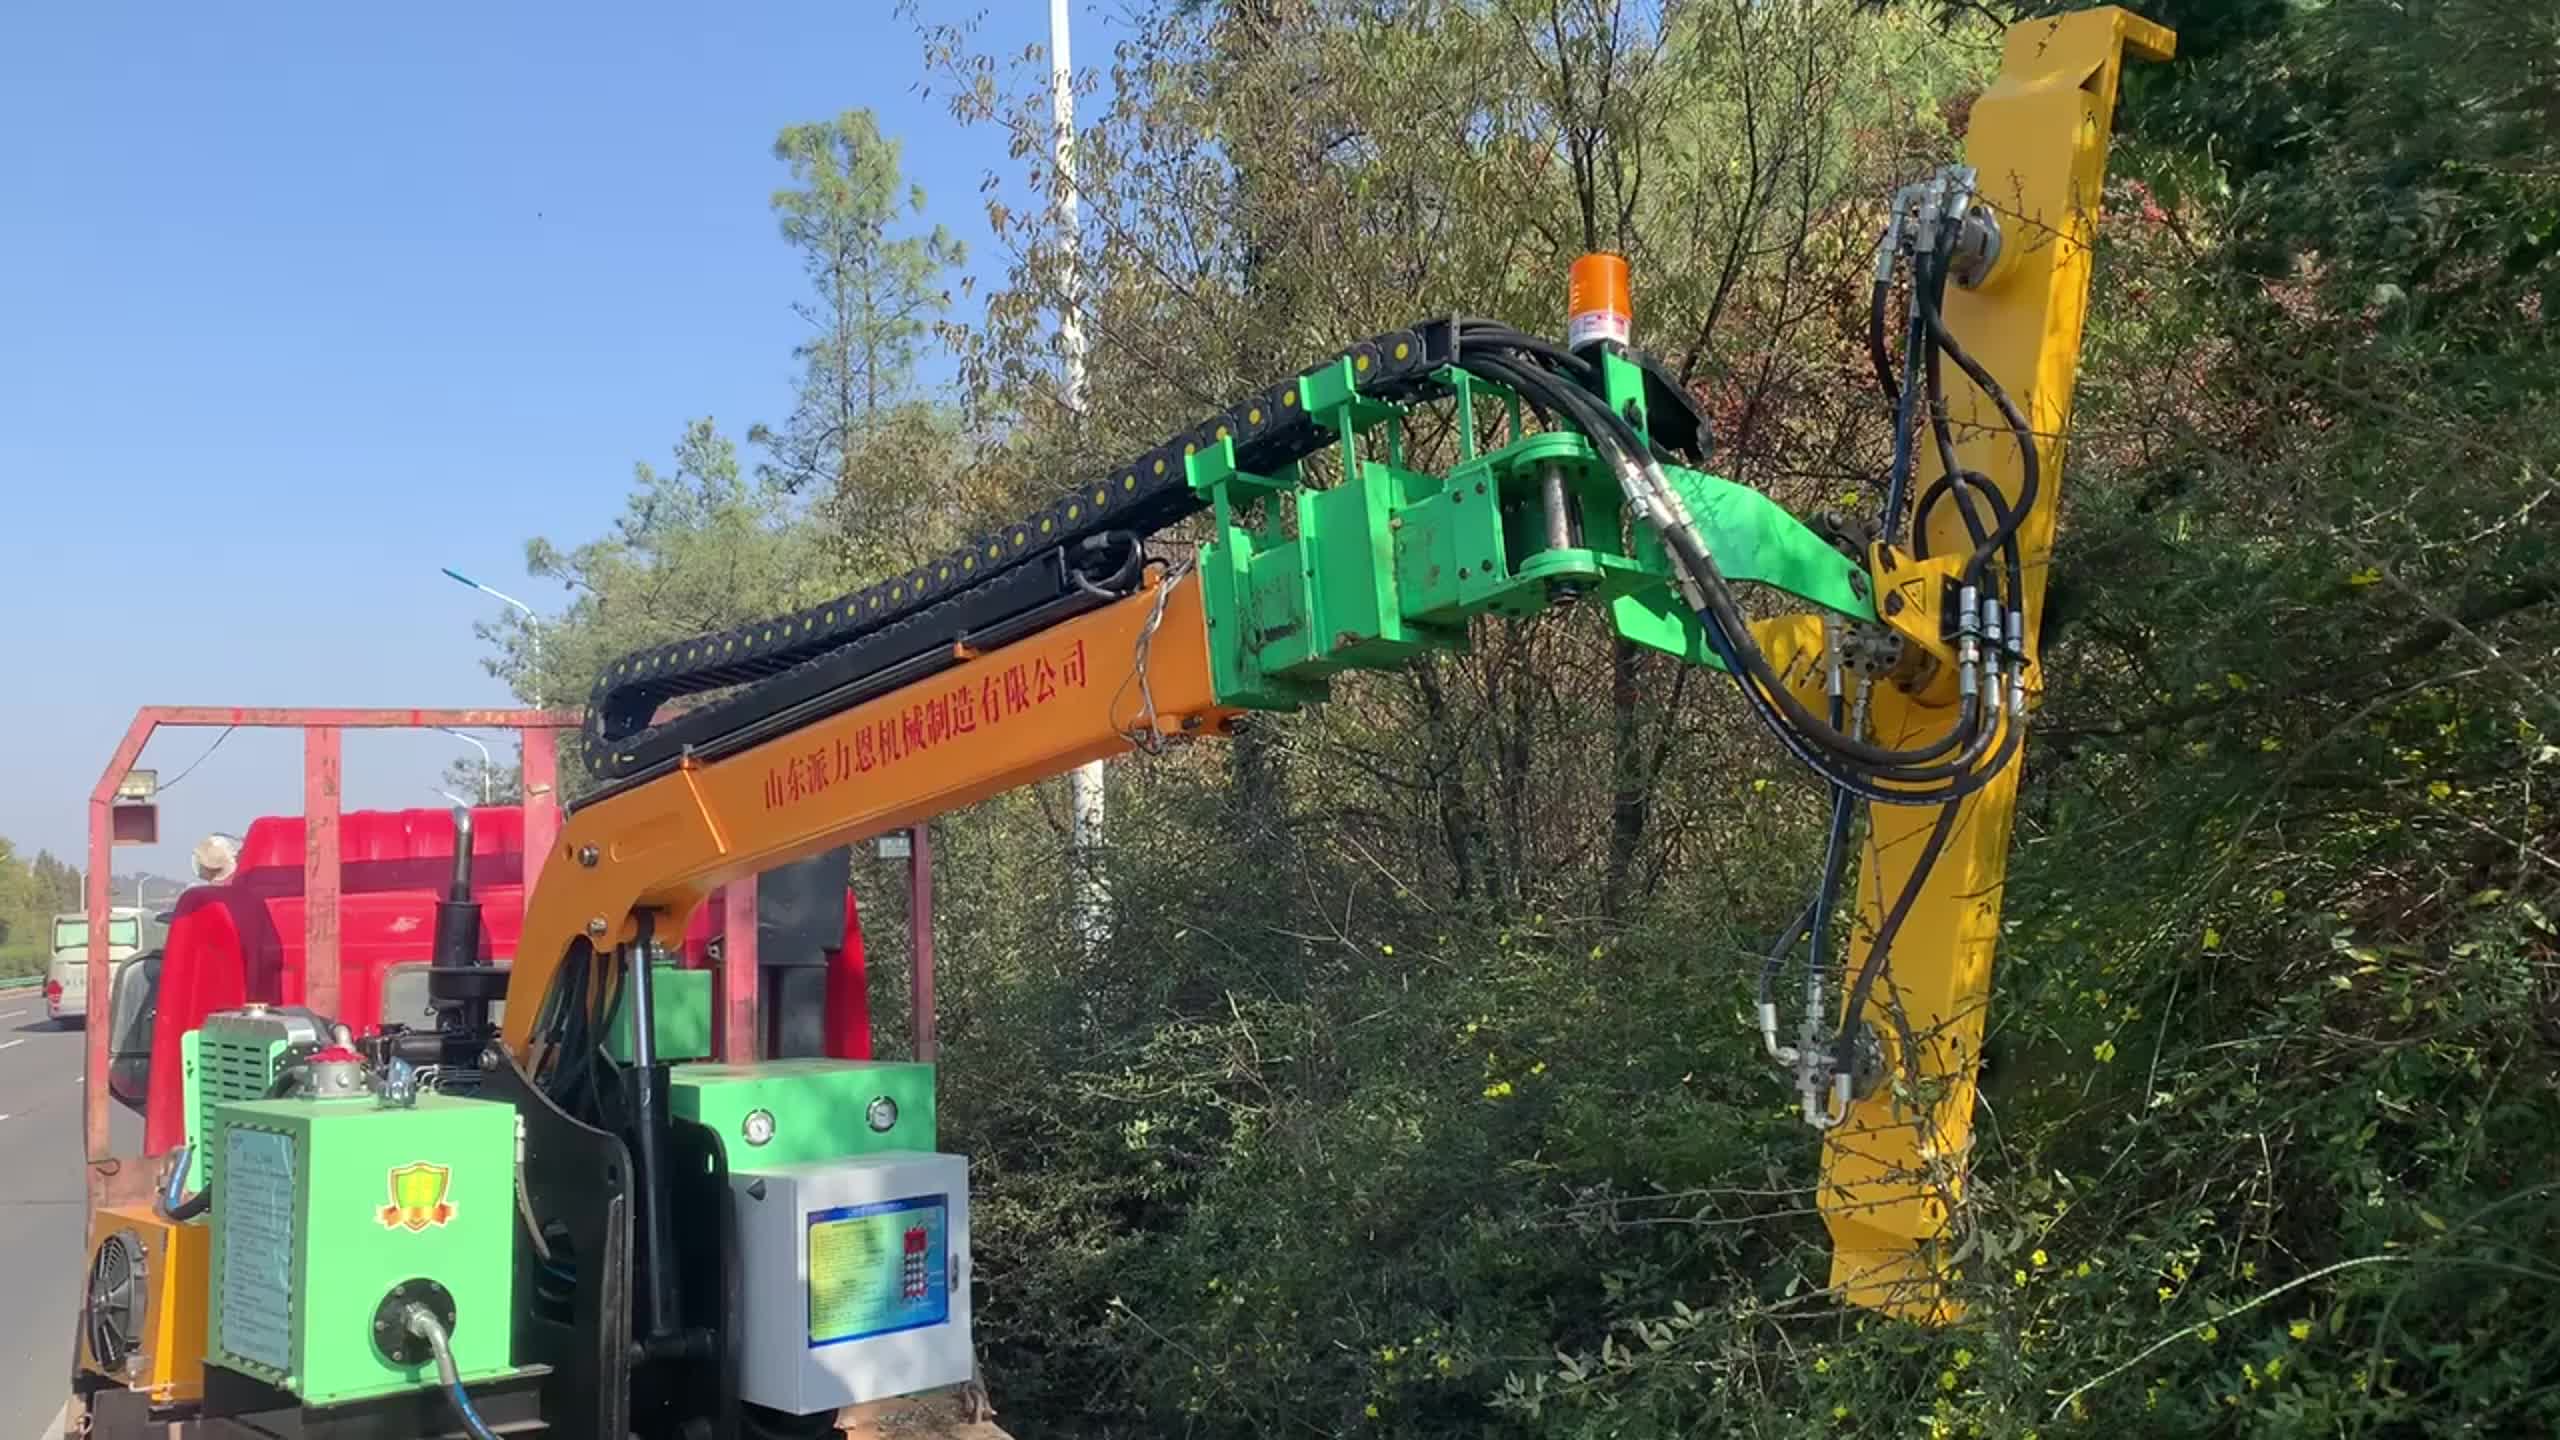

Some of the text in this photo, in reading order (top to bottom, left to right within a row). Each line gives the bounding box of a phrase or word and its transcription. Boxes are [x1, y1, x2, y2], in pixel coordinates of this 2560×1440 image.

[764, 639, 1087, 809] 山东派力恩机械制造有限公司
